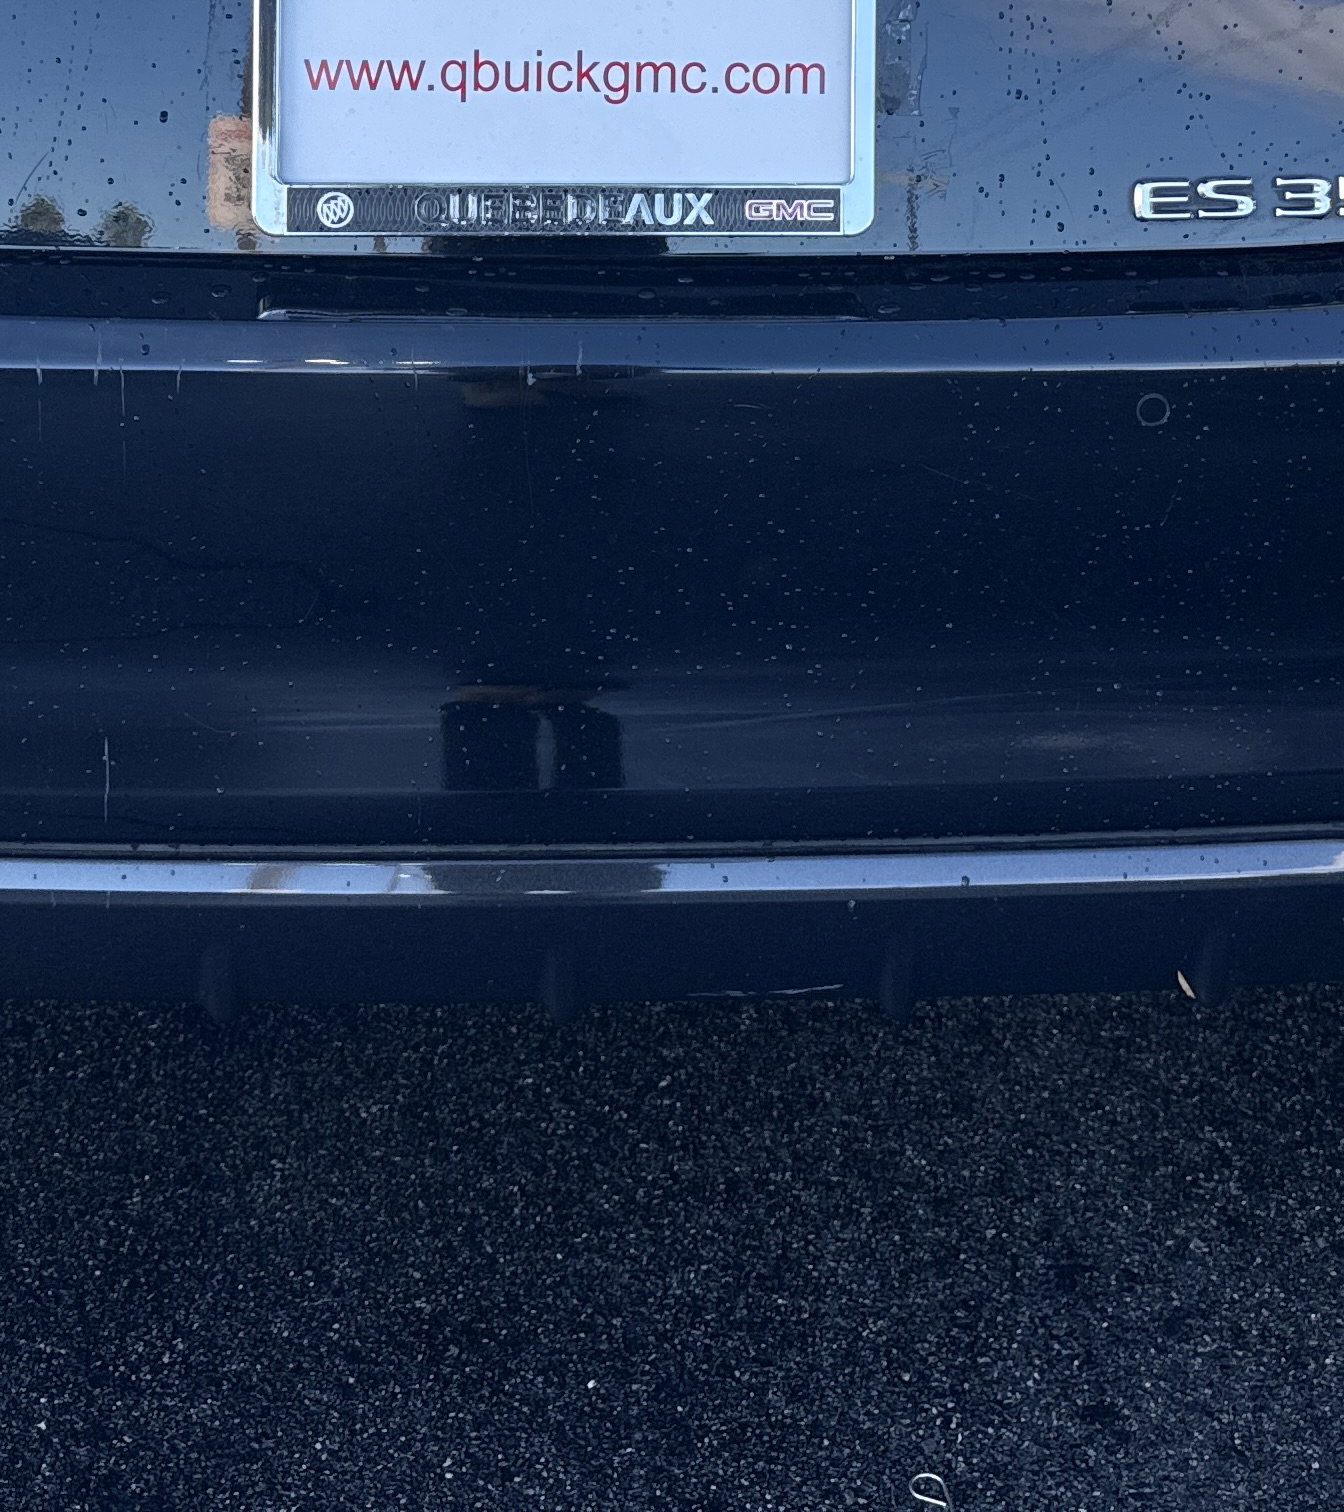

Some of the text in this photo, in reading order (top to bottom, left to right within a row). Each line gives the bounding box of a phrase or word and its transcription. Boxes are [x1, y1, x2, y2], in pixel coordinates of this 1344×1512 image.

[304, 50, 826, 104] www.qbuickgmc.com
[415, 191, 716, 227] QUEBEDEAUX
[744, 198, 835, 221] GMC
[1133, 176, 1257, 220] ES
